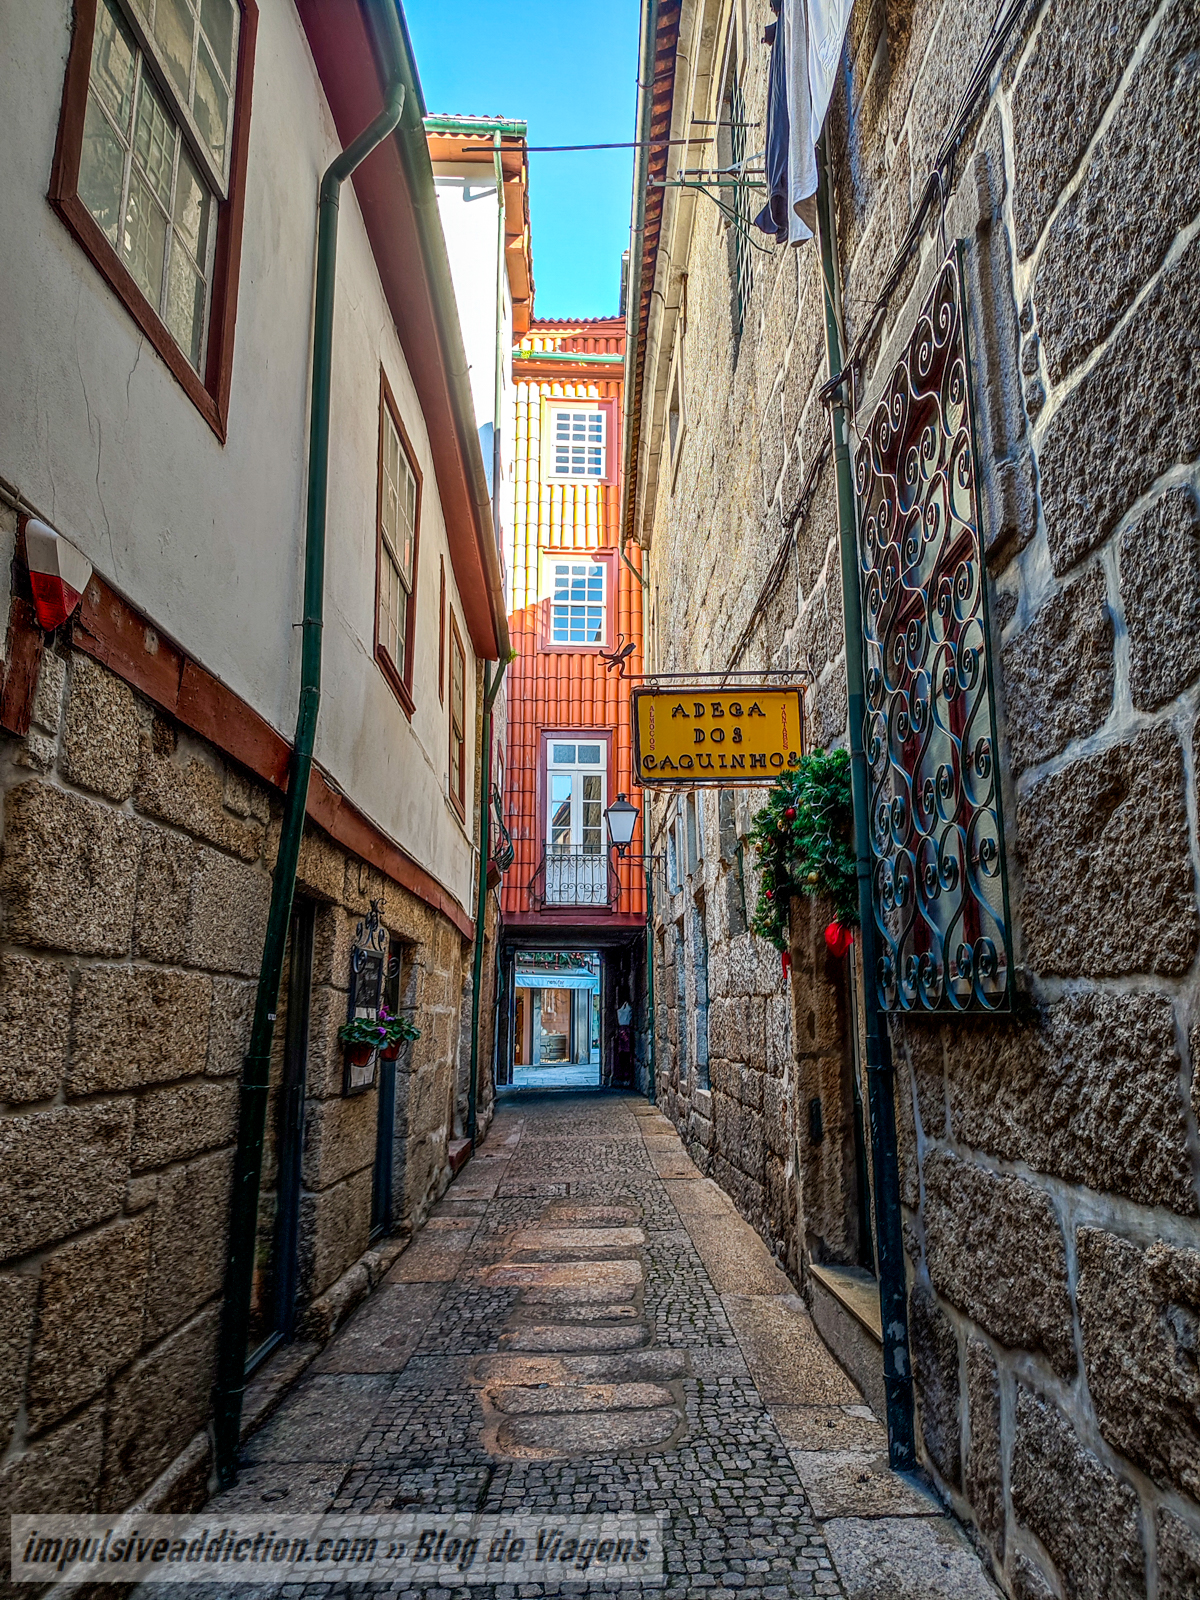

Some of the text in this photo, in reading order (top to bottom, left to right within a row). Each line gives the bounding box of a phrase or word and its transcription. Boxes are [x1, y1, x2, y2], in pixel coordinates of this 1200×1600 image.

[672, 702, 766, 718] ADEGA
[693, 726, 743, 743] DOS
[780, 704, 789, 750] JANTARES
[642, 751, 797, 770] CAQUINHOS
